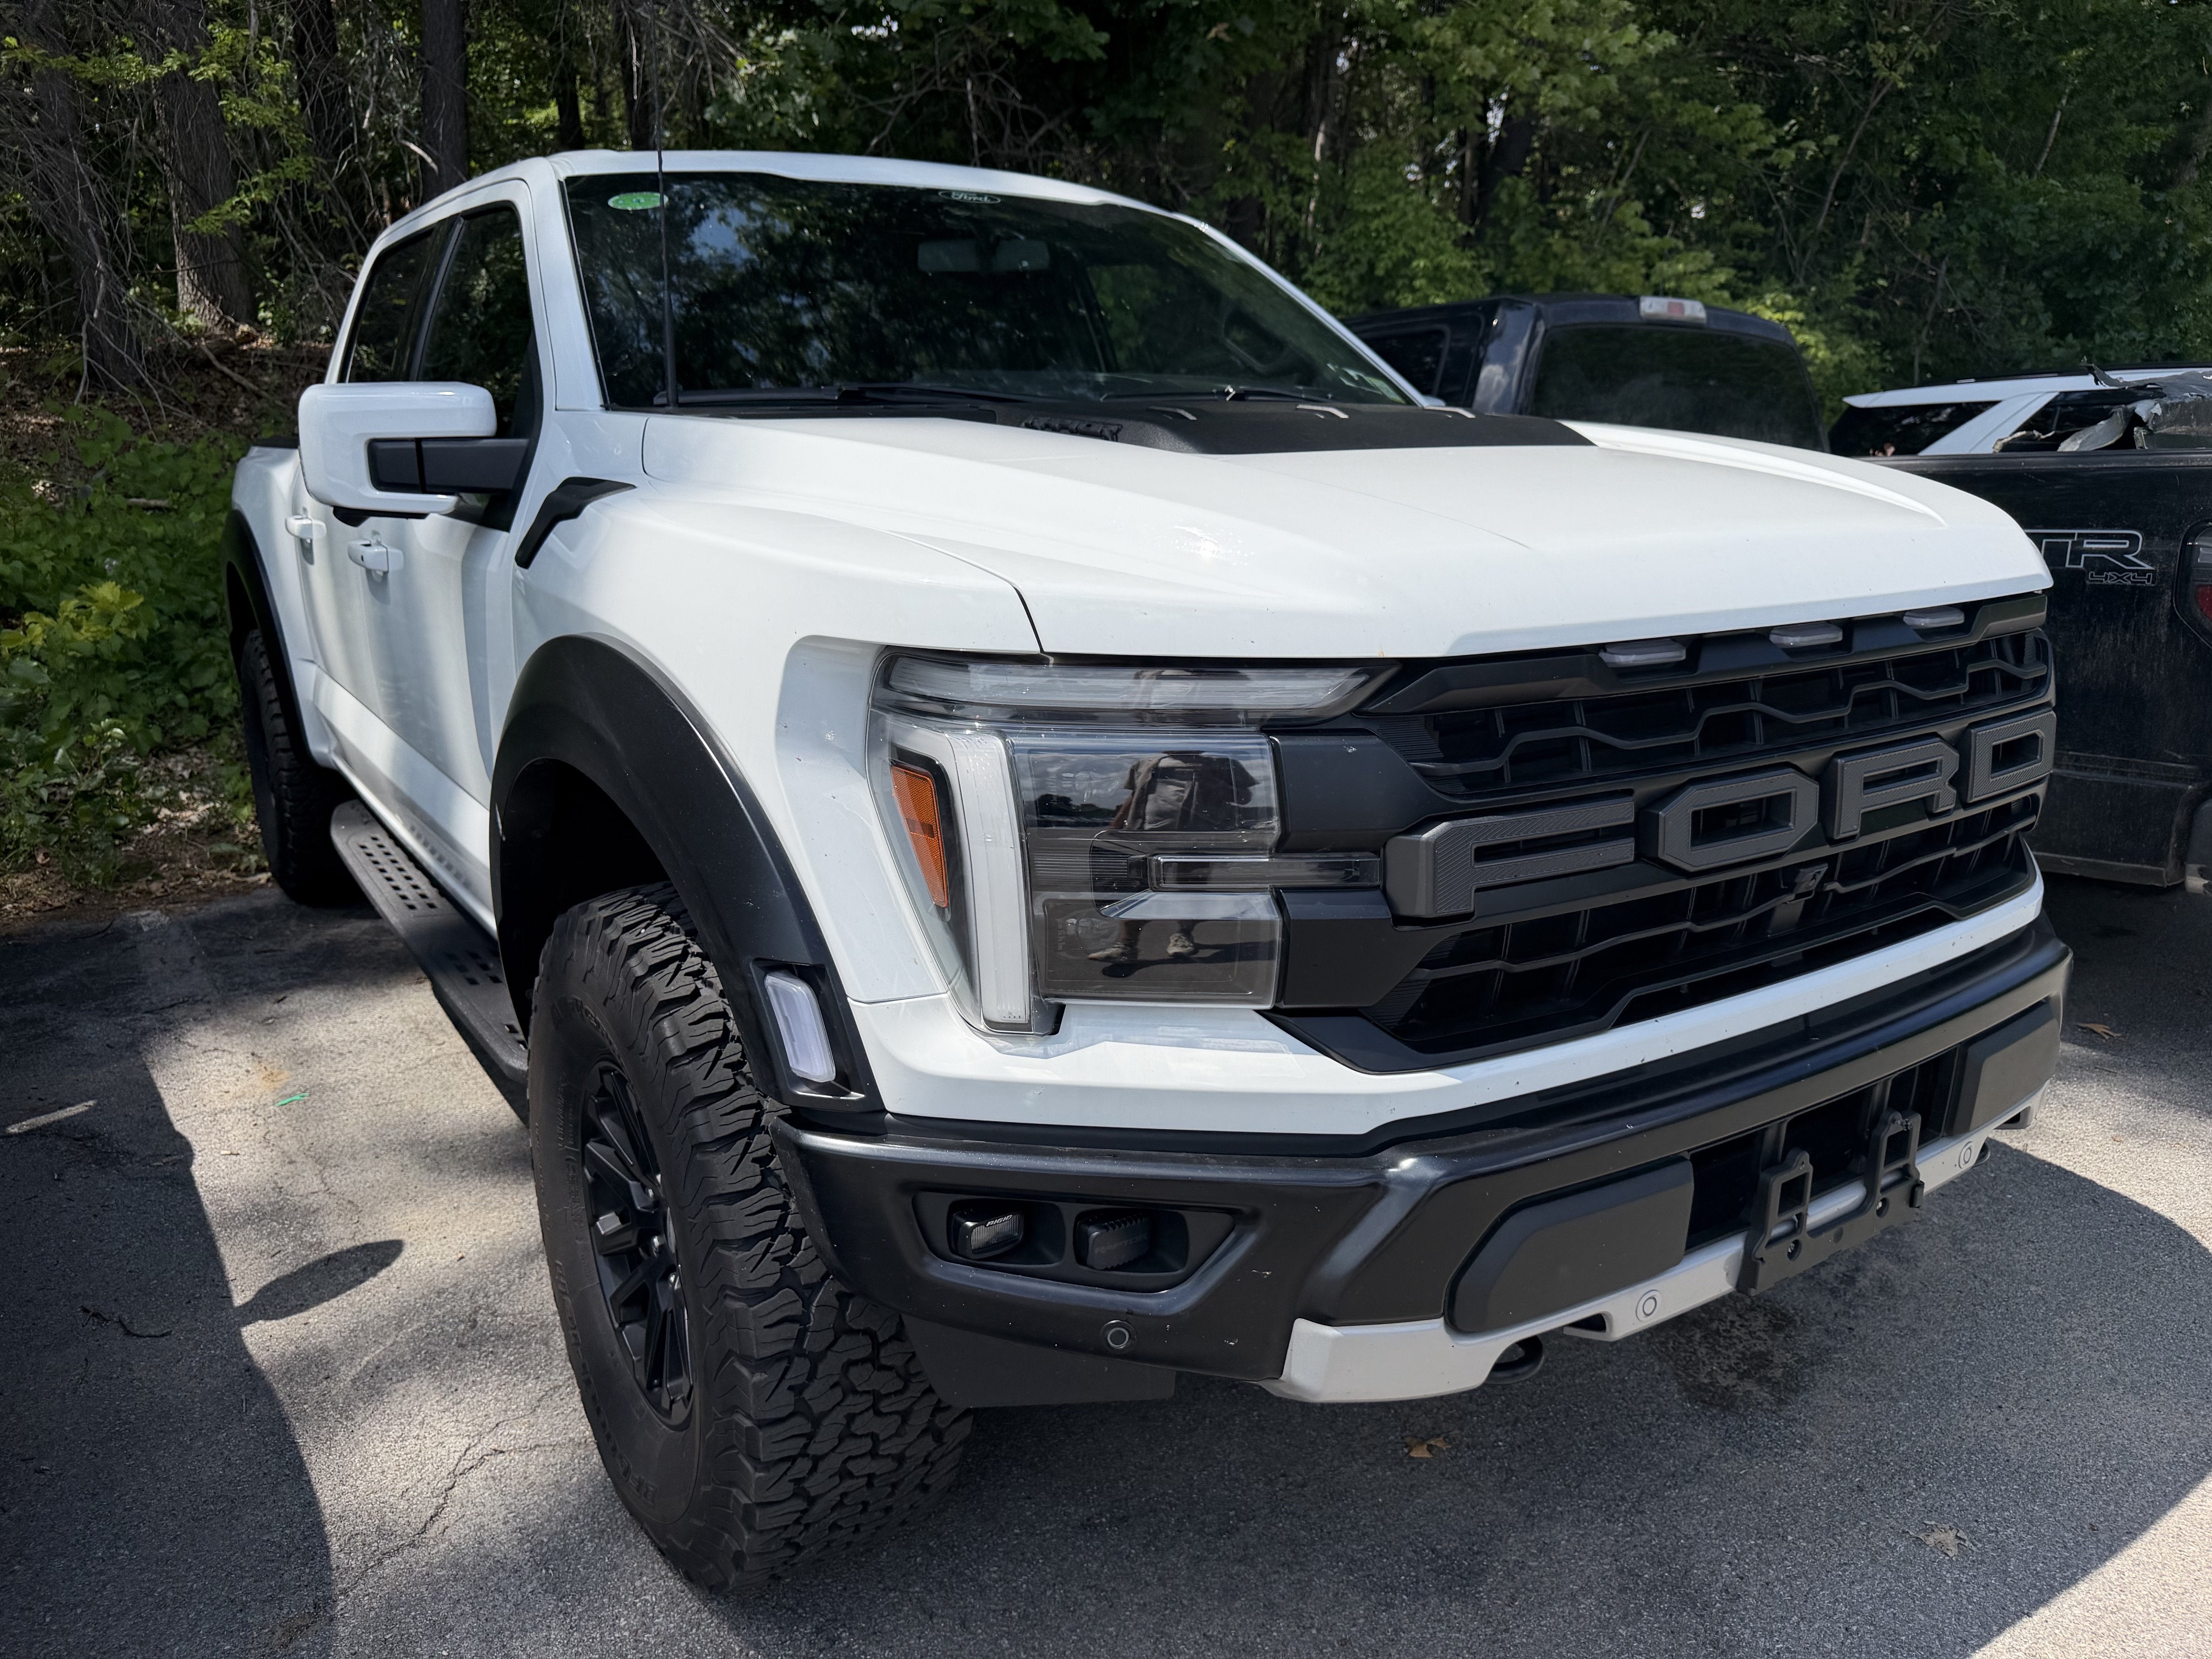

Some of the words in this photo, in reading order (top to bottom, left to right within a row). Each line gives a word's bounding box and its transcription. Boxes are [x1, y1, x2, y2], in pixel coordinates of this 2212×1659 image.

[1386, 709, 2056, 918] FORD
[986, 1214, 1013, 1227] RIGID
[1094, 1232, 1147, 1254] RAPTOR
